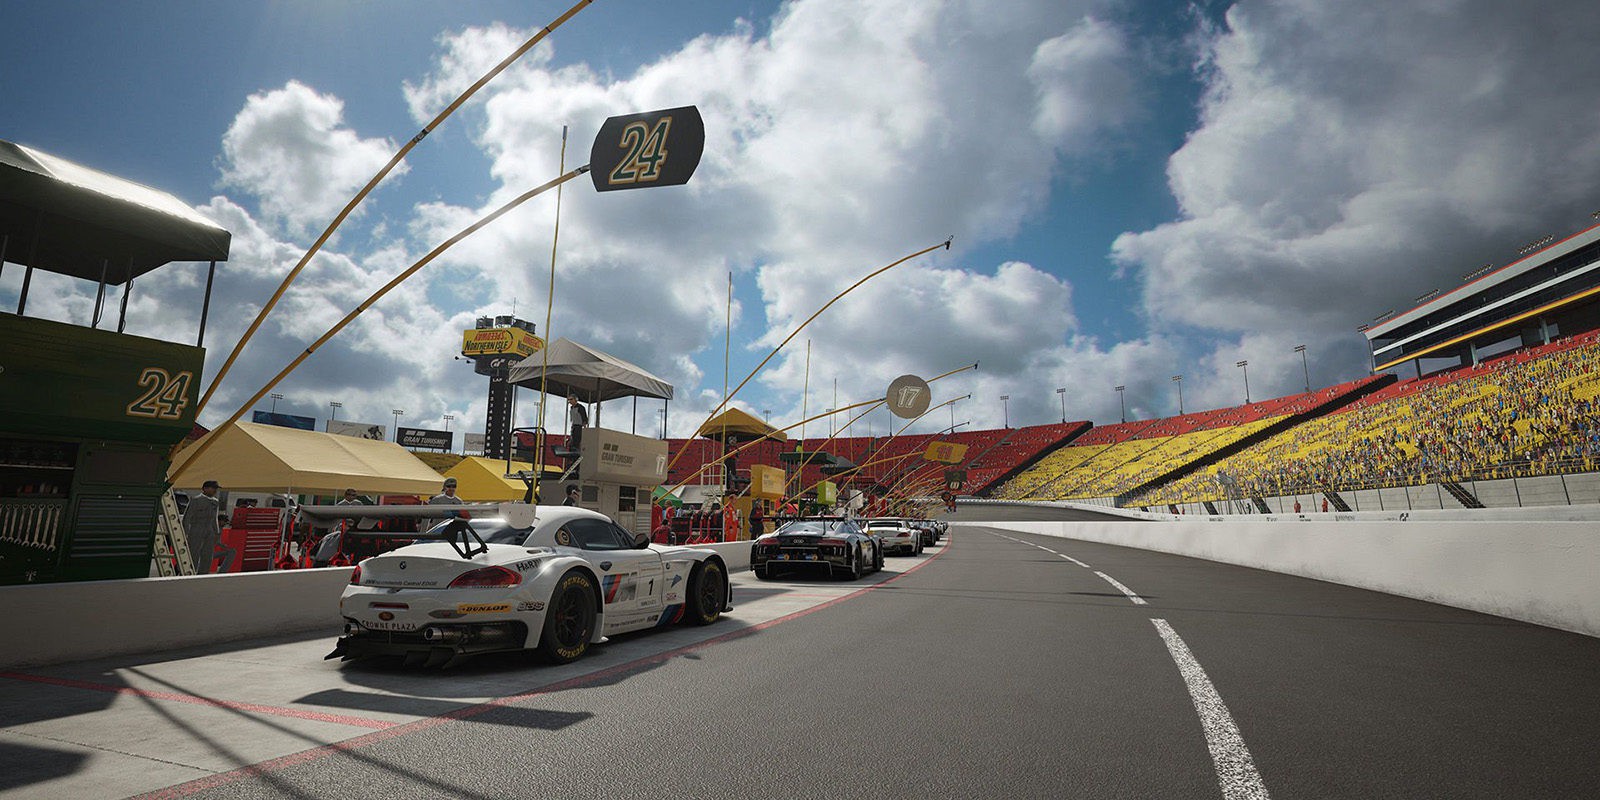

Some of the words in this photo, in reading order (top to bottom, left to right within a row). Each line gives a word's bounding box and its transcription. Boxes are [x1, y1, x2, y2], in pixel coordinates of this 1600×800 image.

[608, 116, 672, 184] 24
[465, 341, 495, 351] NORTHERN
[495, 341, 508, 351] ISLE
[126, 367, 193, 420] 24
[897, 385, 922, 408] 17
[656, 454, 666, 476] 17
[562, 576, 589, 591] DUNLOP
[649, 578, 654, 595] 1
[362, 620, 388, 629] CROWNE
